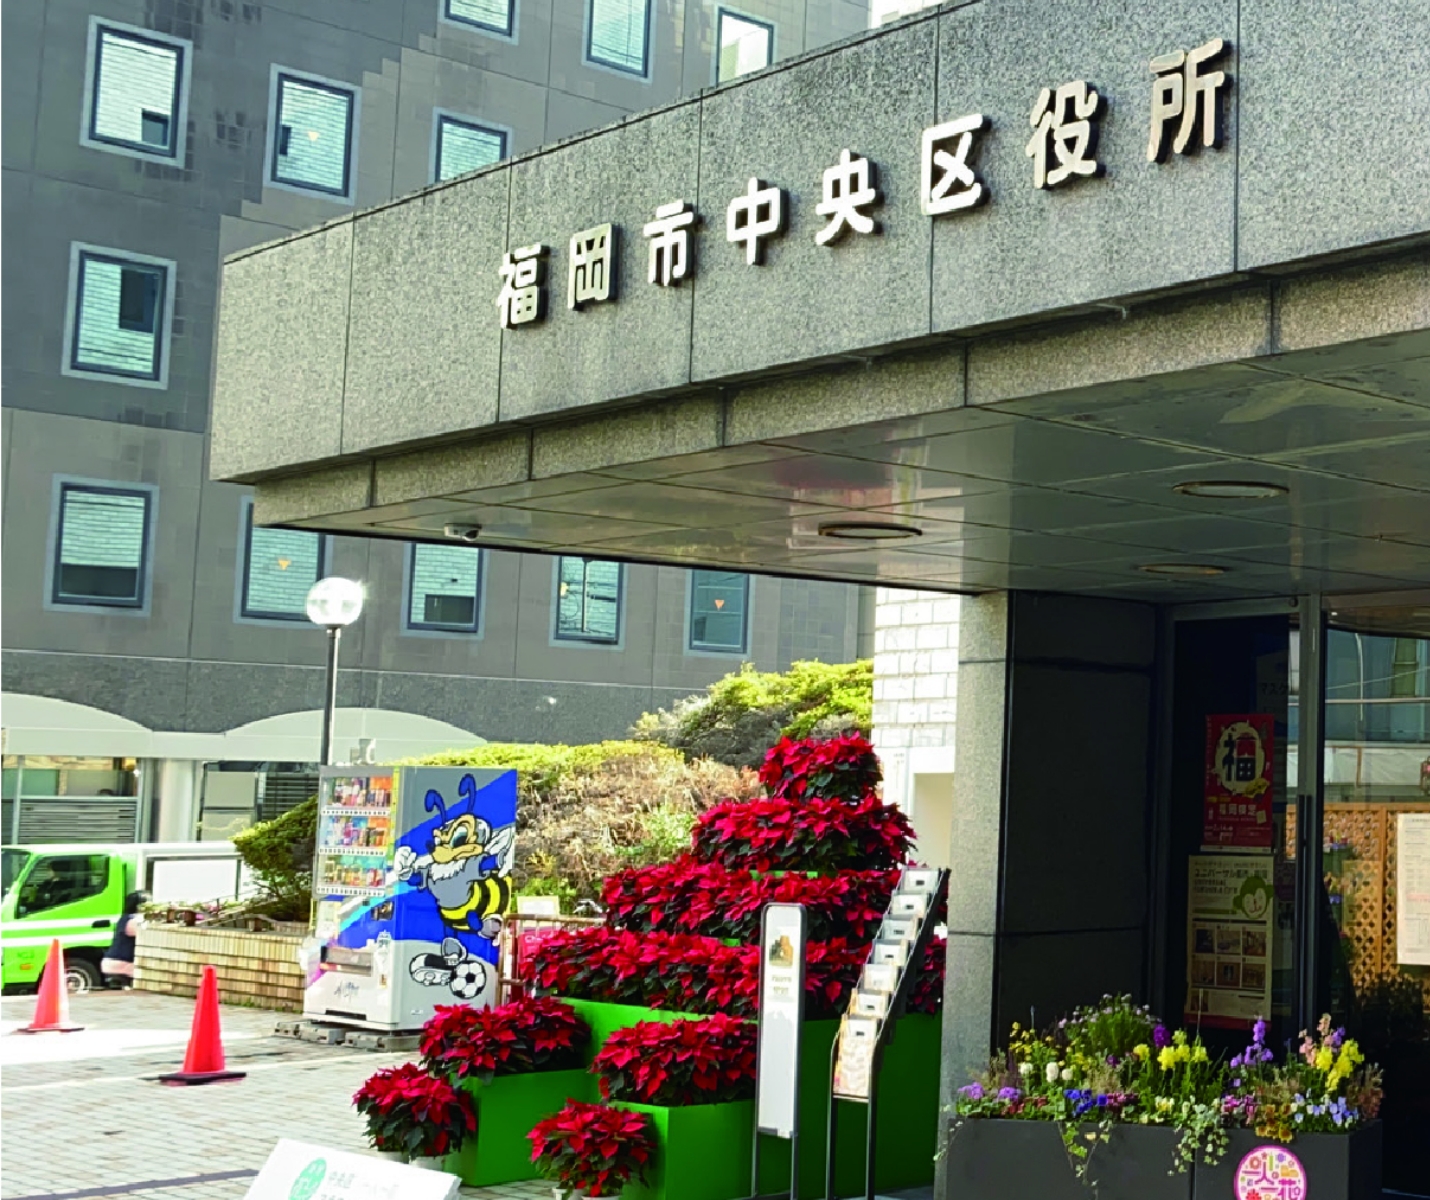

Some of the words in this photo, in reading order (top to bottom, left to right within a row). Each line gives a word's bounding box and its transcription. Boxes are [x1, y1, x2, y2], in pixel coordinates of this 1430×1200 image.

[494, 36, 1231, 330] 福岡市中央区役所
